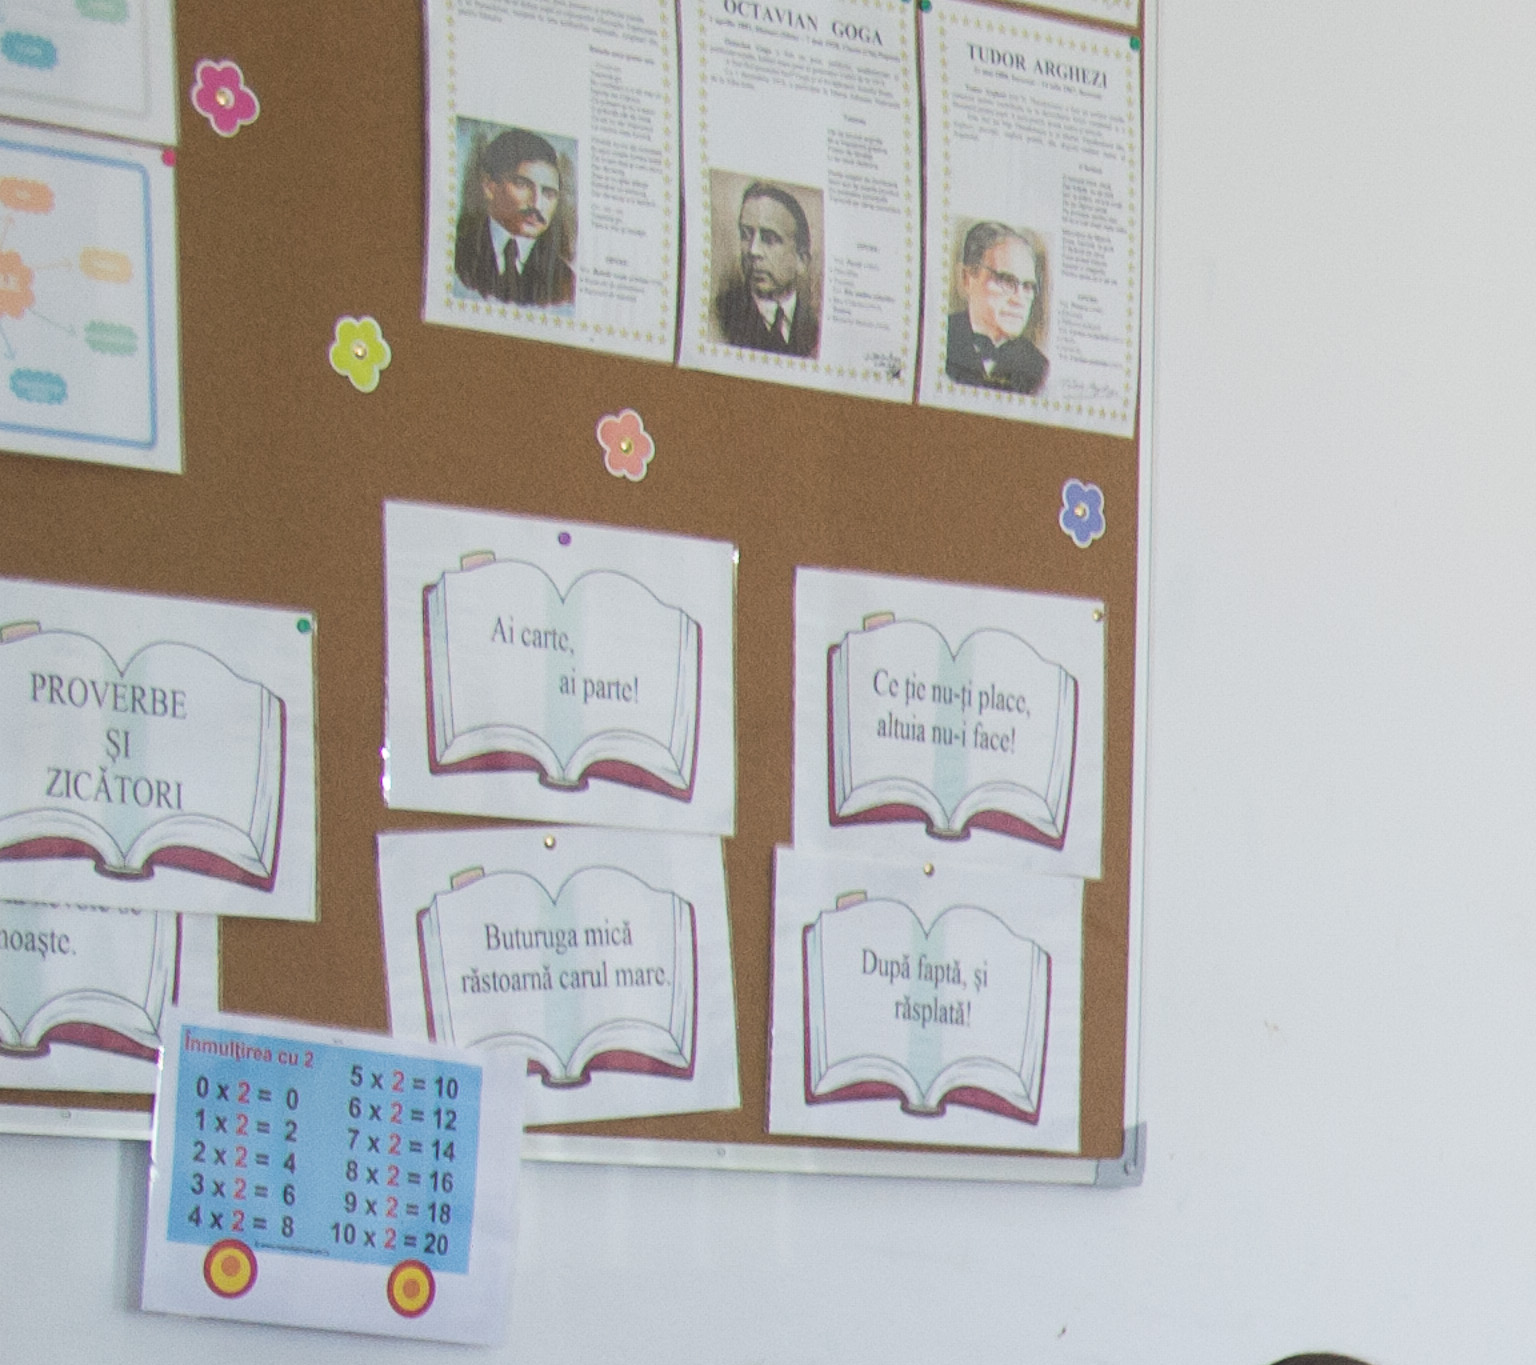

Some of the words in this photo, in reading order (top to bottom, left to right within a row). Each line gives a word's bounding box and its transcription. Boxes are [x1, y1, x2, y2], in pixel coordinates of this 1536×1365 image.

[724, 0, 819, 32] OCTAVIAN
[831, 21, 884, 47] GOGA
[966, 41, 1027, 71] TUDOR
[1033, 59, 1108, 89] ARGHEZI
[491, 615, 514, 645] Ai
[521, 626, 575, 656] carte,
[30, 671, 188, 720] PROVERBE
[559, 667, 577, 696] ai
[583, 676, 639, 705] parte!
[873, 668, 899, 698] Ce
[978, 683, 1032, 719] place,
[877, 711, 926, 744] altuia
[931, 720, 966, 748] nu-i
[973, 721, 1016, 755] face!
[45, 766, 184, 811] ZICĂTORI
[484, 922, 578, 955] Buturuga
[584, 918, 634, 948] mică
[461, 963, 554, 995] răstoarnă
[559, 961, 609, 990] carul
[616, 964, 672, 988] mare.
[861, 948, 911, 985] După
[917, 953, 968, 990] faptă,
[894, 994, 972, 1030] răsplată!
[277, 1050, 300, 1067] cu
[303, 1051, 315, 1069] 2
[196, 1076, 209, 1099] 0
[216, 1082, 230, 1099] x
[237, 1081, 250, 1105] 2
[258, 1088, 272, 1101] =
[286, 1087, 299, 1111] 0
[351, 1065, 363, 1088] 5
[371, 1073, 384, 1090] x
[391, 1070, 405, 1093] 2
[413, 1077, 427, 1090] =
[435, 1076, 459, 1100] 10
[195, 1108, 206, 1131] 1
[215, 1117, 228, 1133] x
[235, 1113, 249, 1136] 2
[256, 1121, 270, 1134] =
[285, 1120, 298, 1142] 2
[349, 1097, 362, 1119] 6
[369, 1105, 382, 1122] x
[390, 1102, 403, 1125] 2
[411, 1109, 425, 1122] =
[433, 1108, 457, 1131] 12
[193, 1141, 206, 1163] 2
[213, 1150, 226, 1166] x
[234, 1146, 248, 1168] 2
[255, 1153, 269, 1166] =
[283, 1152, 296, 1174] 4
[348, 1128, 360, 1150] 7
[367, 1137, 380, 1153] x
[388, 1133, 401, 1156] 2
[409, 1141, 423, 1154] =
[431, 1140, 456, 1163] 14
[191, 1173, 205, 1195] 3
[212, 1182, 225, 1198] x
[233, 1178, 247, 1200] 2
[254, 1185, 268, 1198] =
[283, 1184, 296, 1206] 6
[346, 1160, 358, 1182] 8
[366, 1168, 379, 1185] x
[387, 1165, 400, 1187] 2
[408, 1172, 421, 1185] =
[429, 1171, 454, 1194] 16
[188, 1205, 202, 1228] 4
[210, 1213, 223, 1230] x
[231, 1210, 245, 1232] 2
[253, 1217, 267, 1230] =
[282, 1215, 294, 1238] 8
[345, 1191, 357, 1213] 9
[365, 1200, 378, 1216] x
[385, 1196, 398, 1219] 2
[406, 1204, 420, 1216] =
[428, 1202, 452, 1225] 18
[331, 1222, 357, 1245] 10
[363, 1231, 376, 1248] x
[384, 1227, 397, 1250] 2
[403, 1234, 418, 1248] =
[424, 1232, 449, 1256] 20
